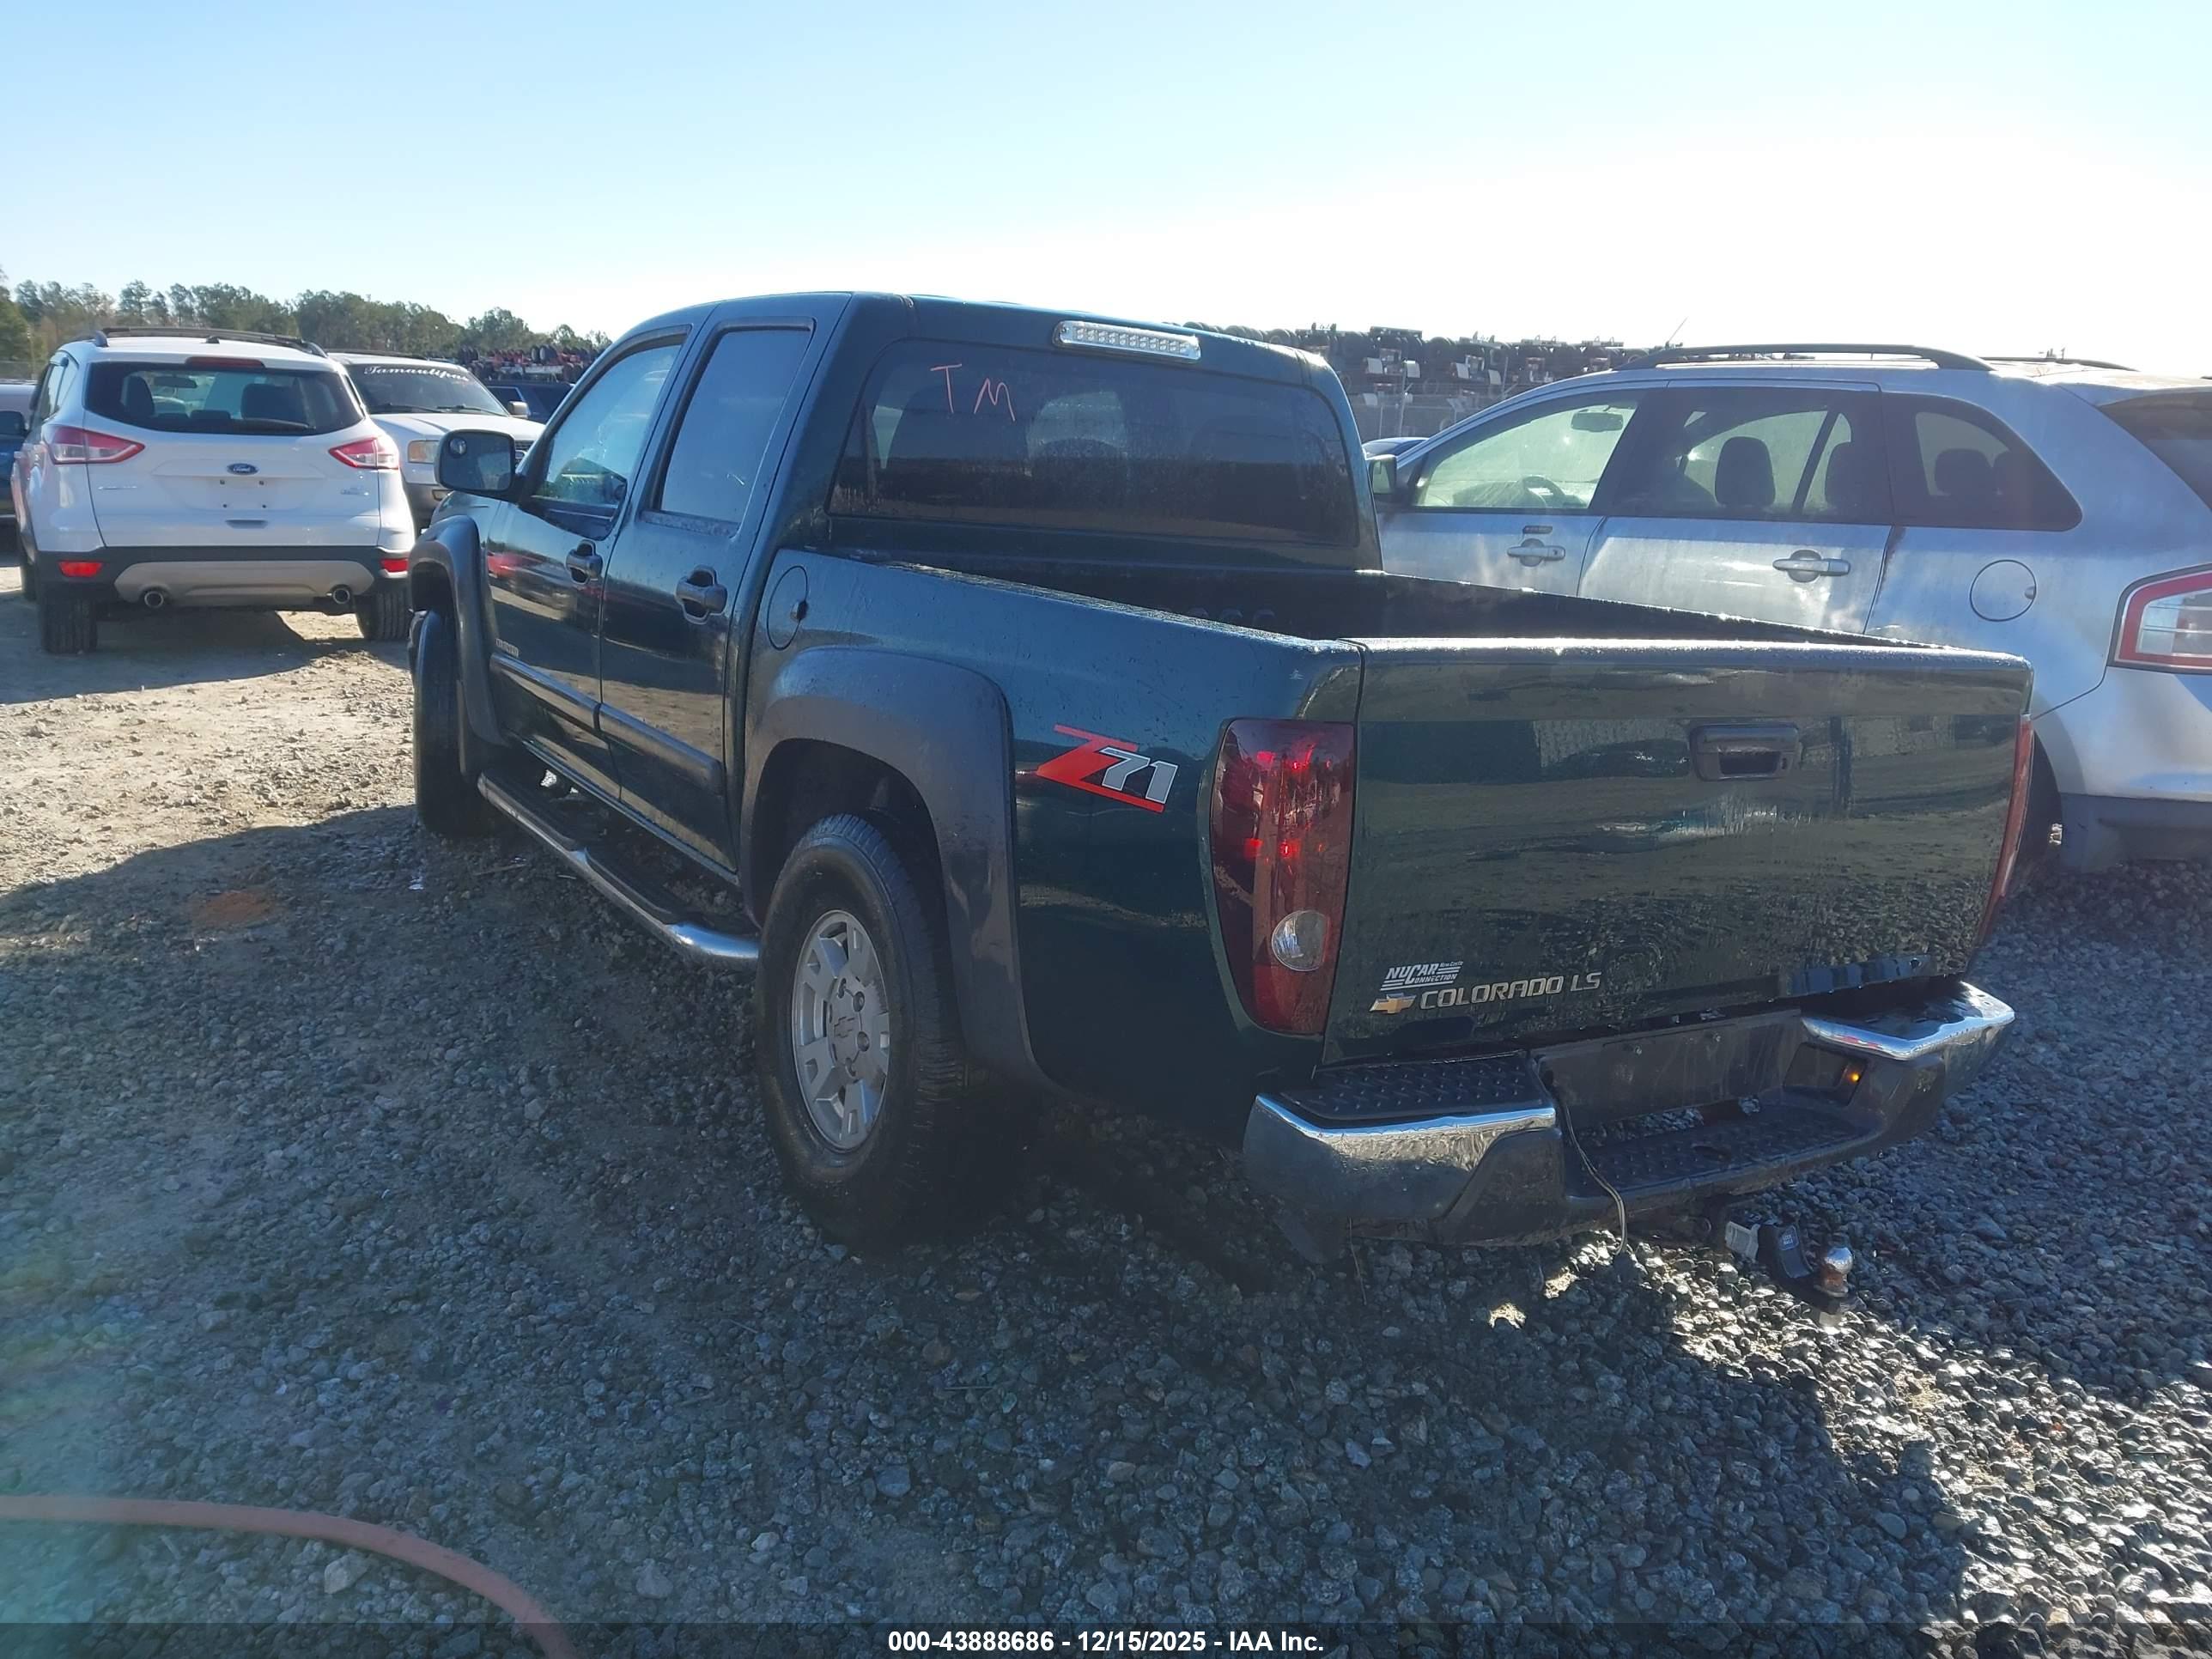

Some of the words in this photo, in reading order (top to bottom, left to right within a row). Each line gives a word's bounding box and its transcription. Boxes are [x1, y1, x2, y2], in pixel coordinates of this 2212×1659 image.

[364, 366, 469, 381] Tamaulipas
[1036, 724, 1178, 813] Z71
[1419, 975, 1564, 1009] COLORADO
[1571, 972, 1601, 992] LS
